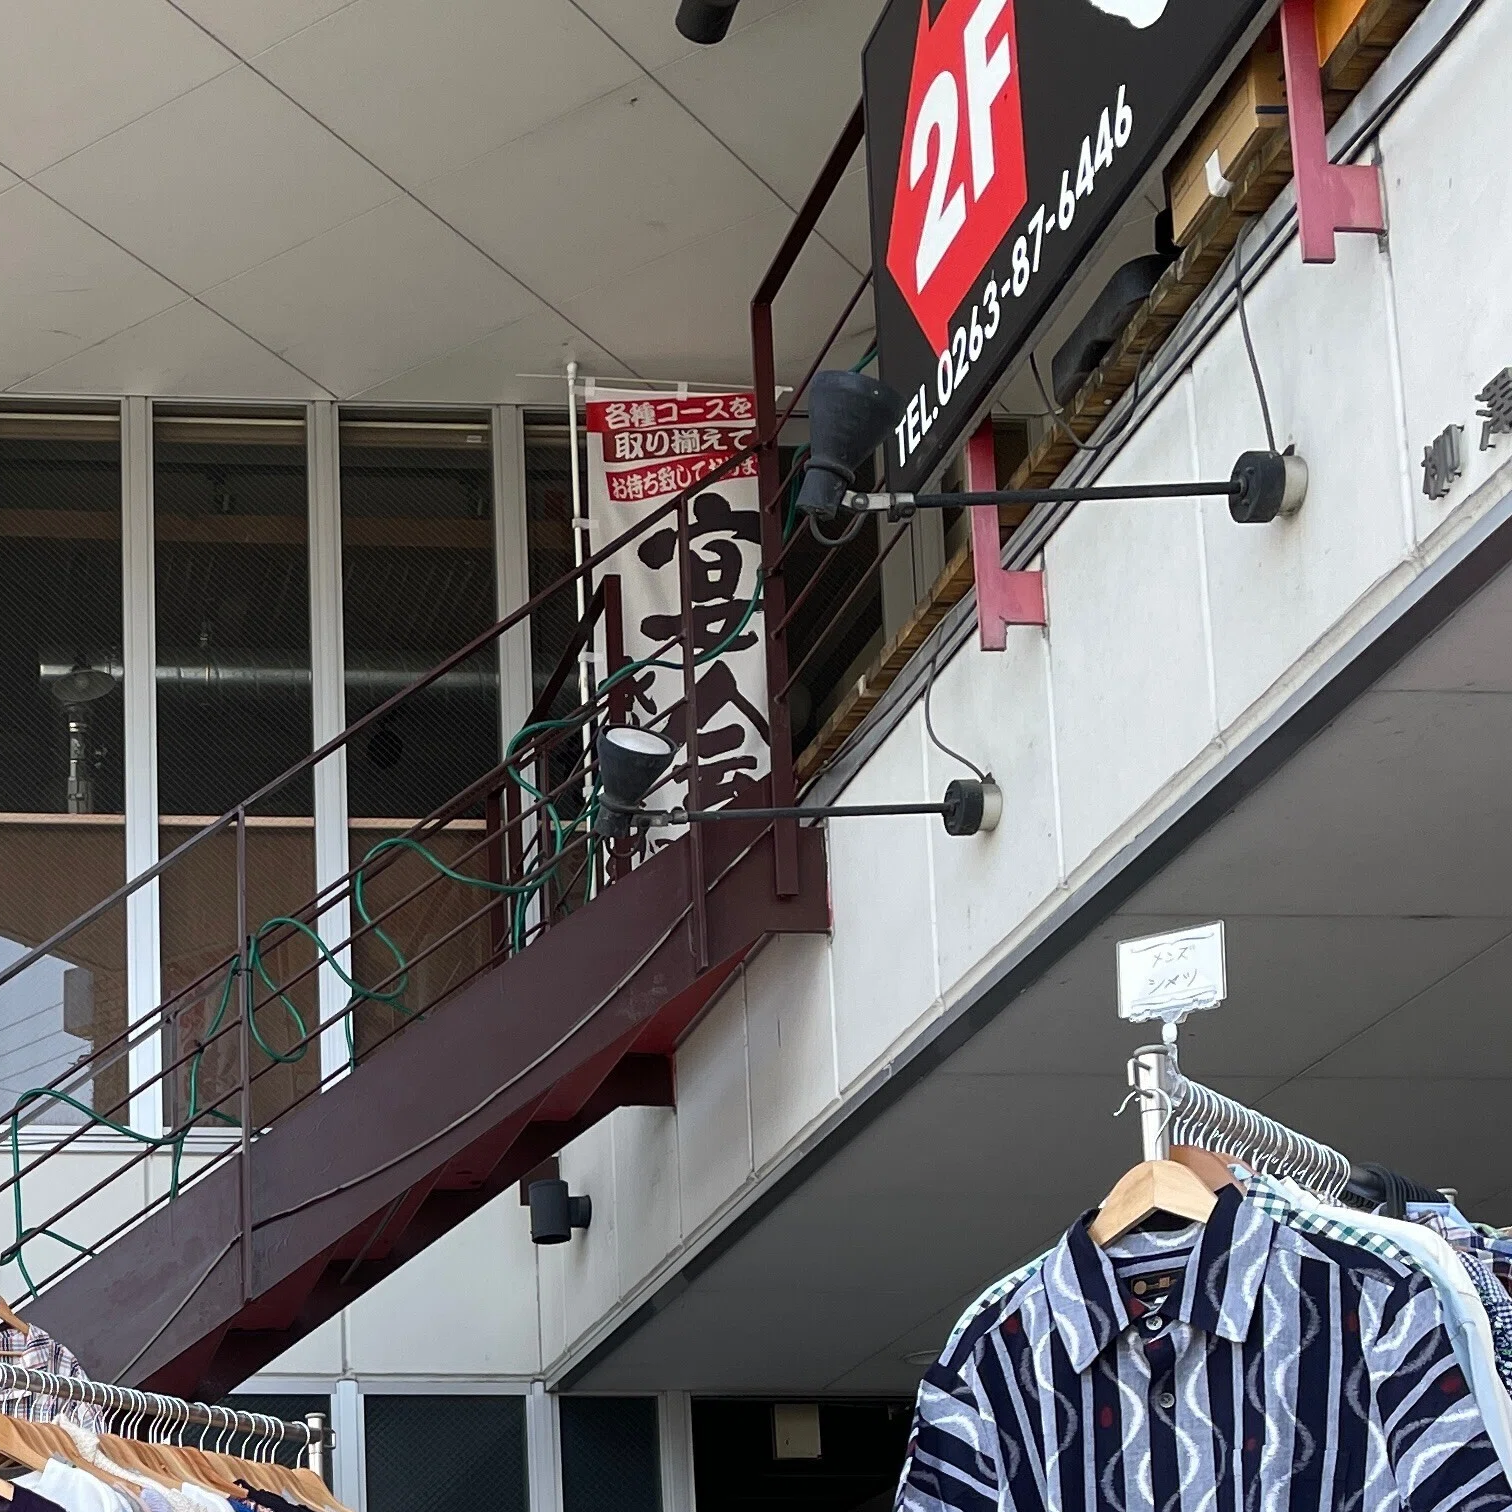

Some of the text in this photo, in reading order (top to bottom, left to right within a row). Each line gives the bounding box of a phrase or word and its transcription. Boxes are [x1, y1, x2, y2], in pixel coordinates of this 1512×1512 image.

[909, 0, 1011, 295] 2F
[605, 396, 752, 430] 各種コースを
[614, 428, 753, 461] 取り揃えて
[1152, 944, 1195, 968] メンズ
[1148, 969, 1197, 995] シャツ
